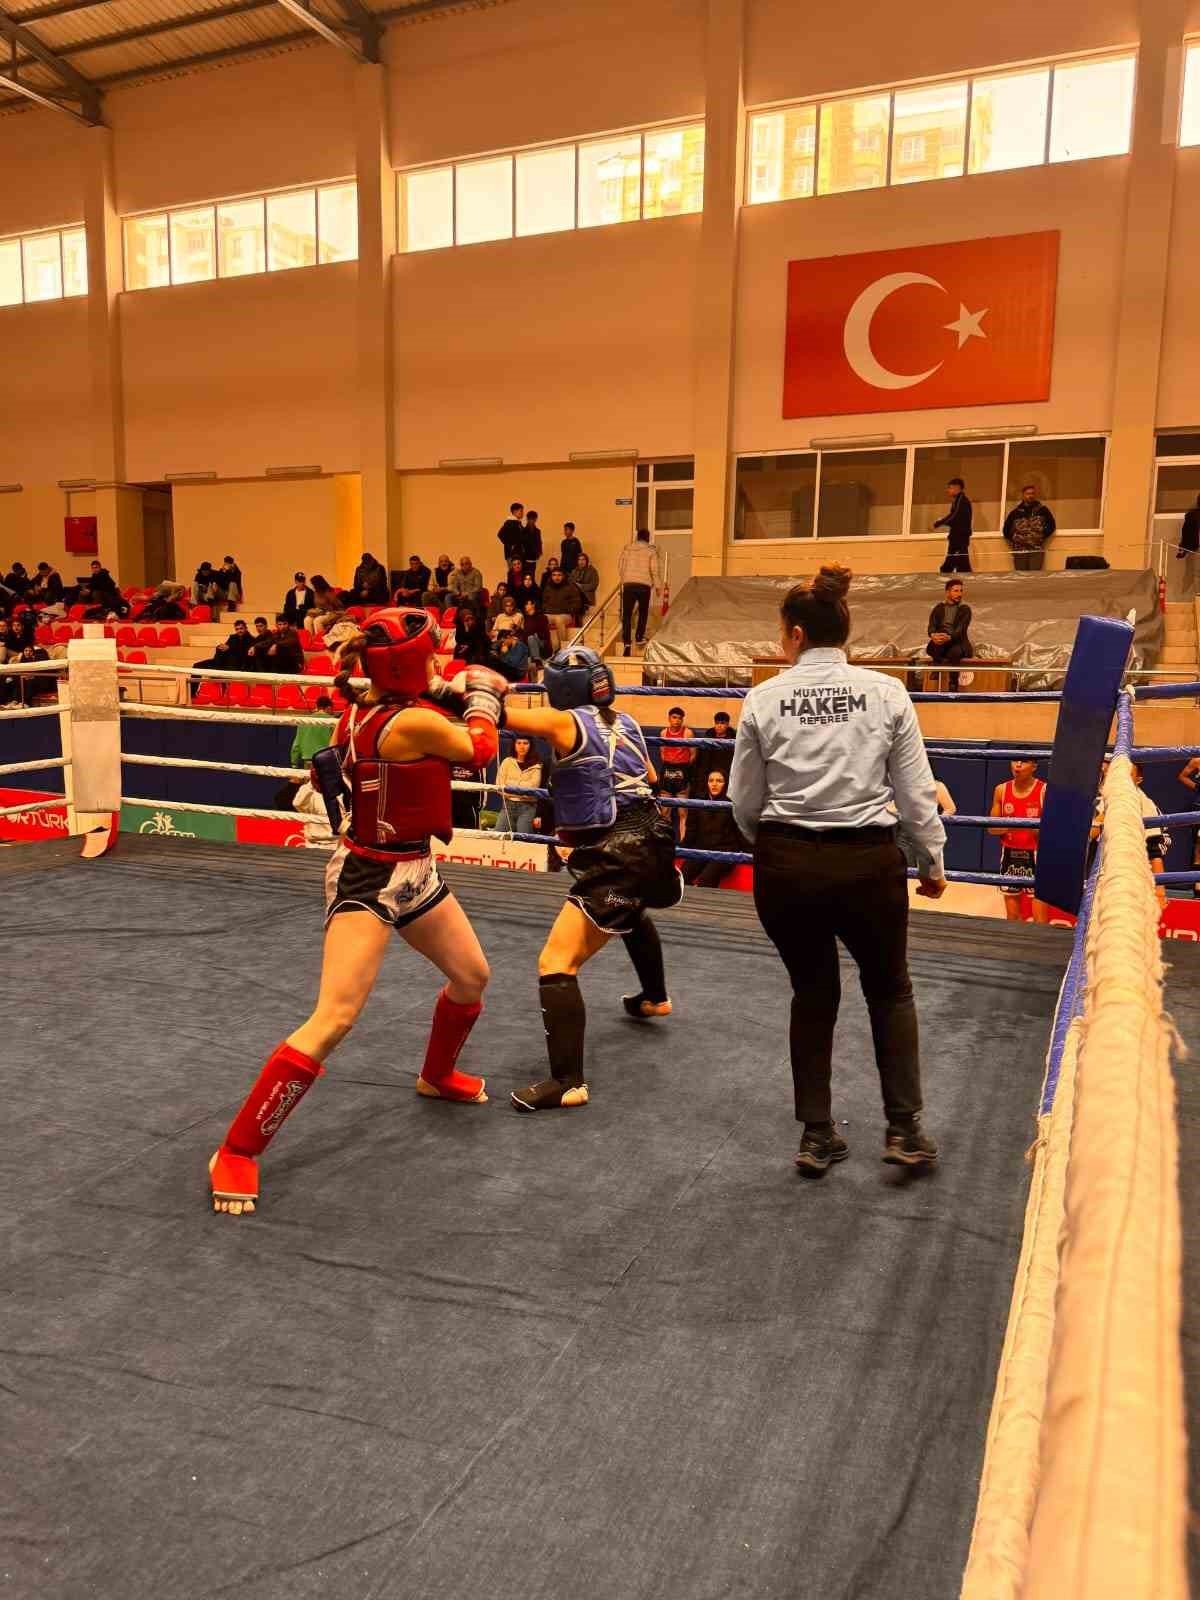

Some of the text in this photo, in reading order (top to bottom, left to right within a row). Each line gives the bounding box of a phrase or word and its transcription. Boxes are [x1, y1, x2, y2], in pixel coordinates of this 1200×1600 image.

[793, 686, 852, 697] MUAYTHAI
[780, 694, 866, 716] HAKEM
[800, 714, 848, 724] REFEREE
